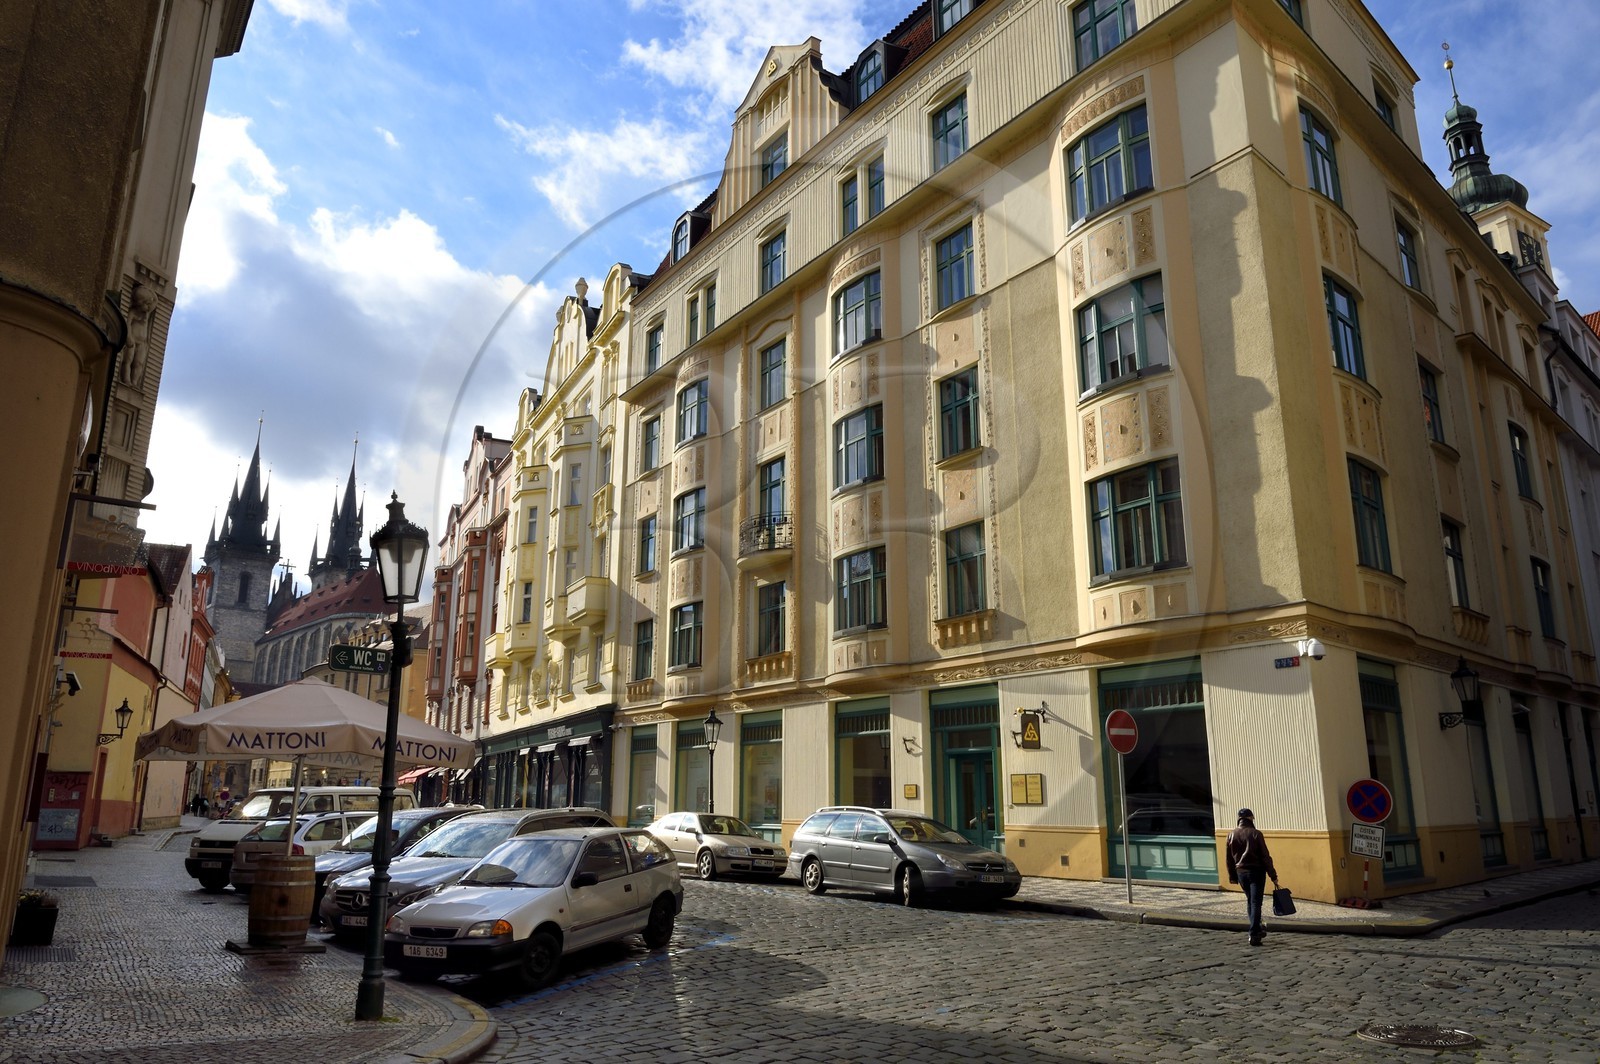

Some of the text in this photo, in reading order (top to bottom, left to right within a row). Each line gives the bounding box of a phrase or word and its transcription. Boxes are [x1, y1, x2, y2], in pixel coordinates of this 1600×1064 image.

[353, 649, 372, 666] WC
[226, 731, 326, 749] MATTONI
[409, 946, 444, 957] 1A6 6349
